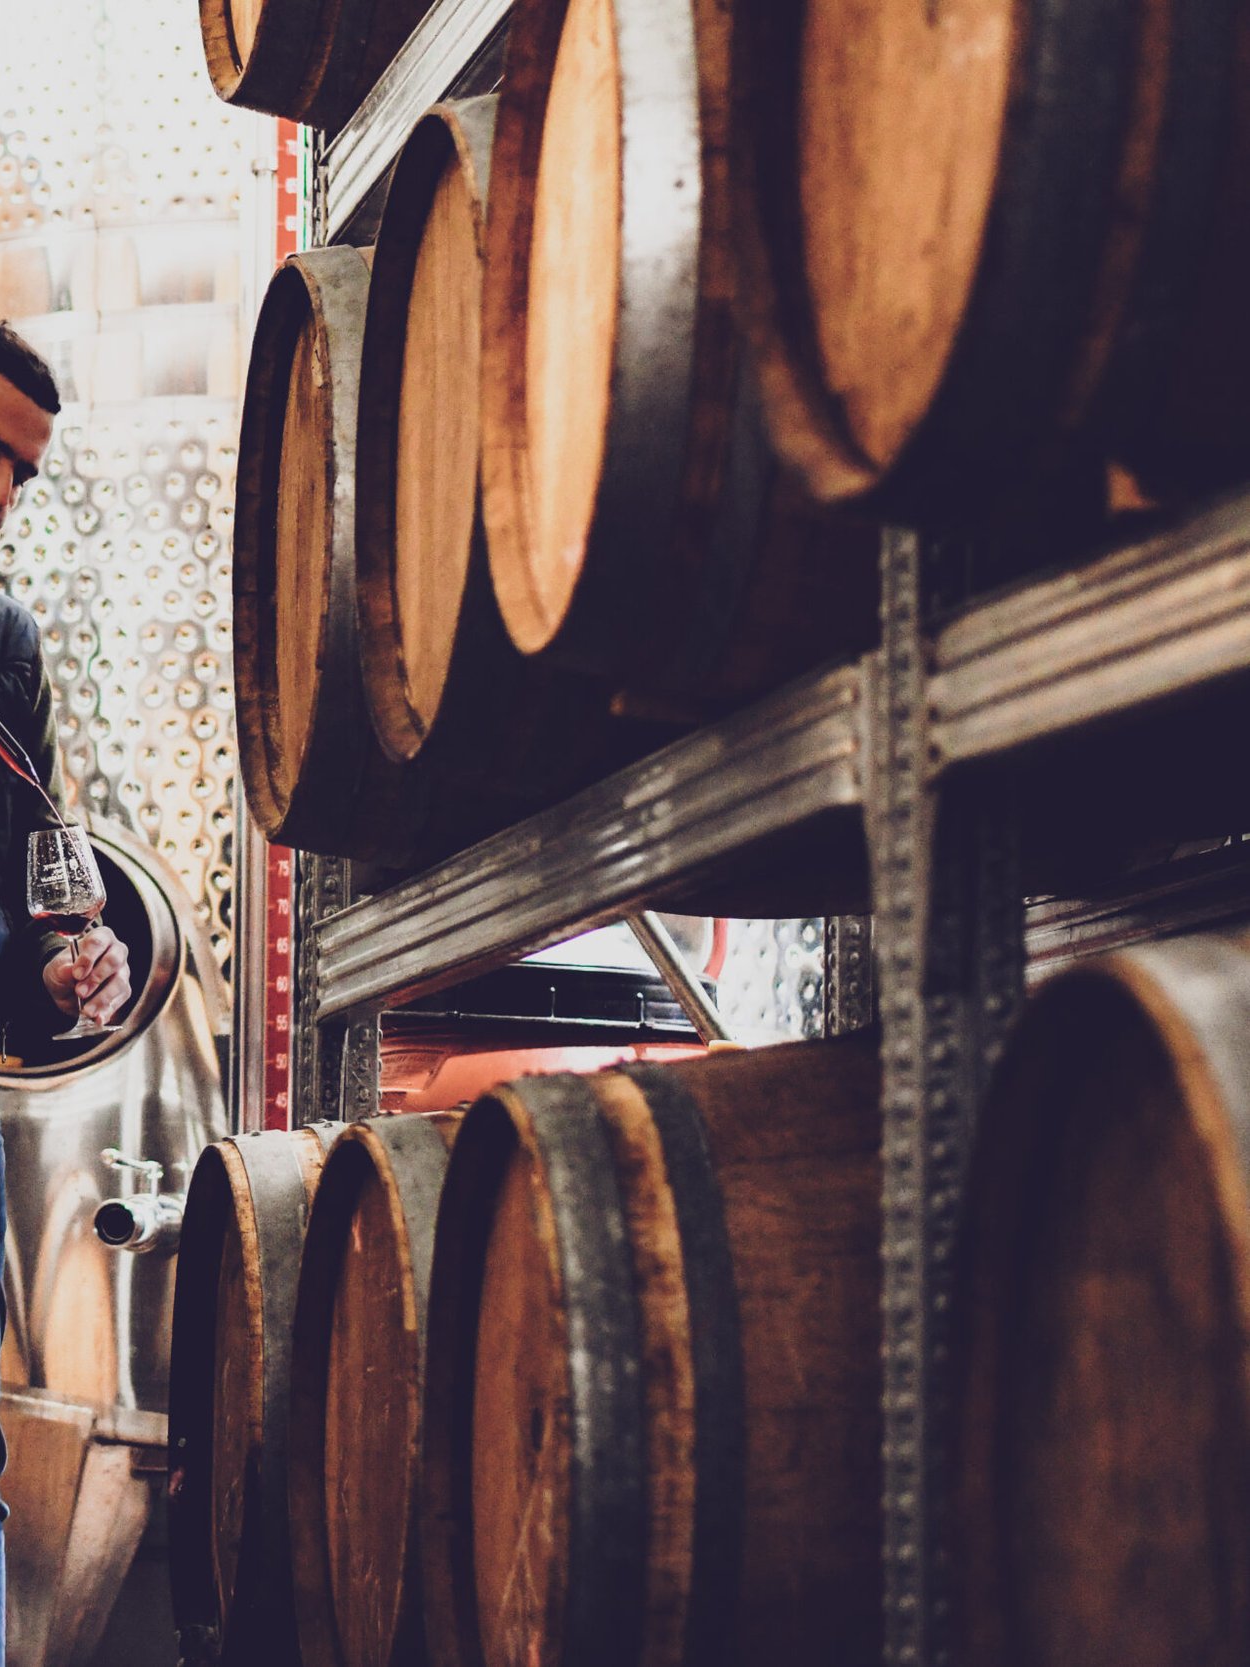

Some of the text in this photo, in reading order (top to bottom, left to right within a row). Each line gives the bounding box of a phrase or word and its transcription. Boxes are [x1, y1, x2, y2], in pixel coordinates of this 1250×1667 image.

[278, 860, 290, 877] 75
[277, 898, 289, 915] 70
[275, 1014, 288, 1031] 55
[275, 1053, 288, 1069] 50
[275, 1092, 288, 1108] 45
